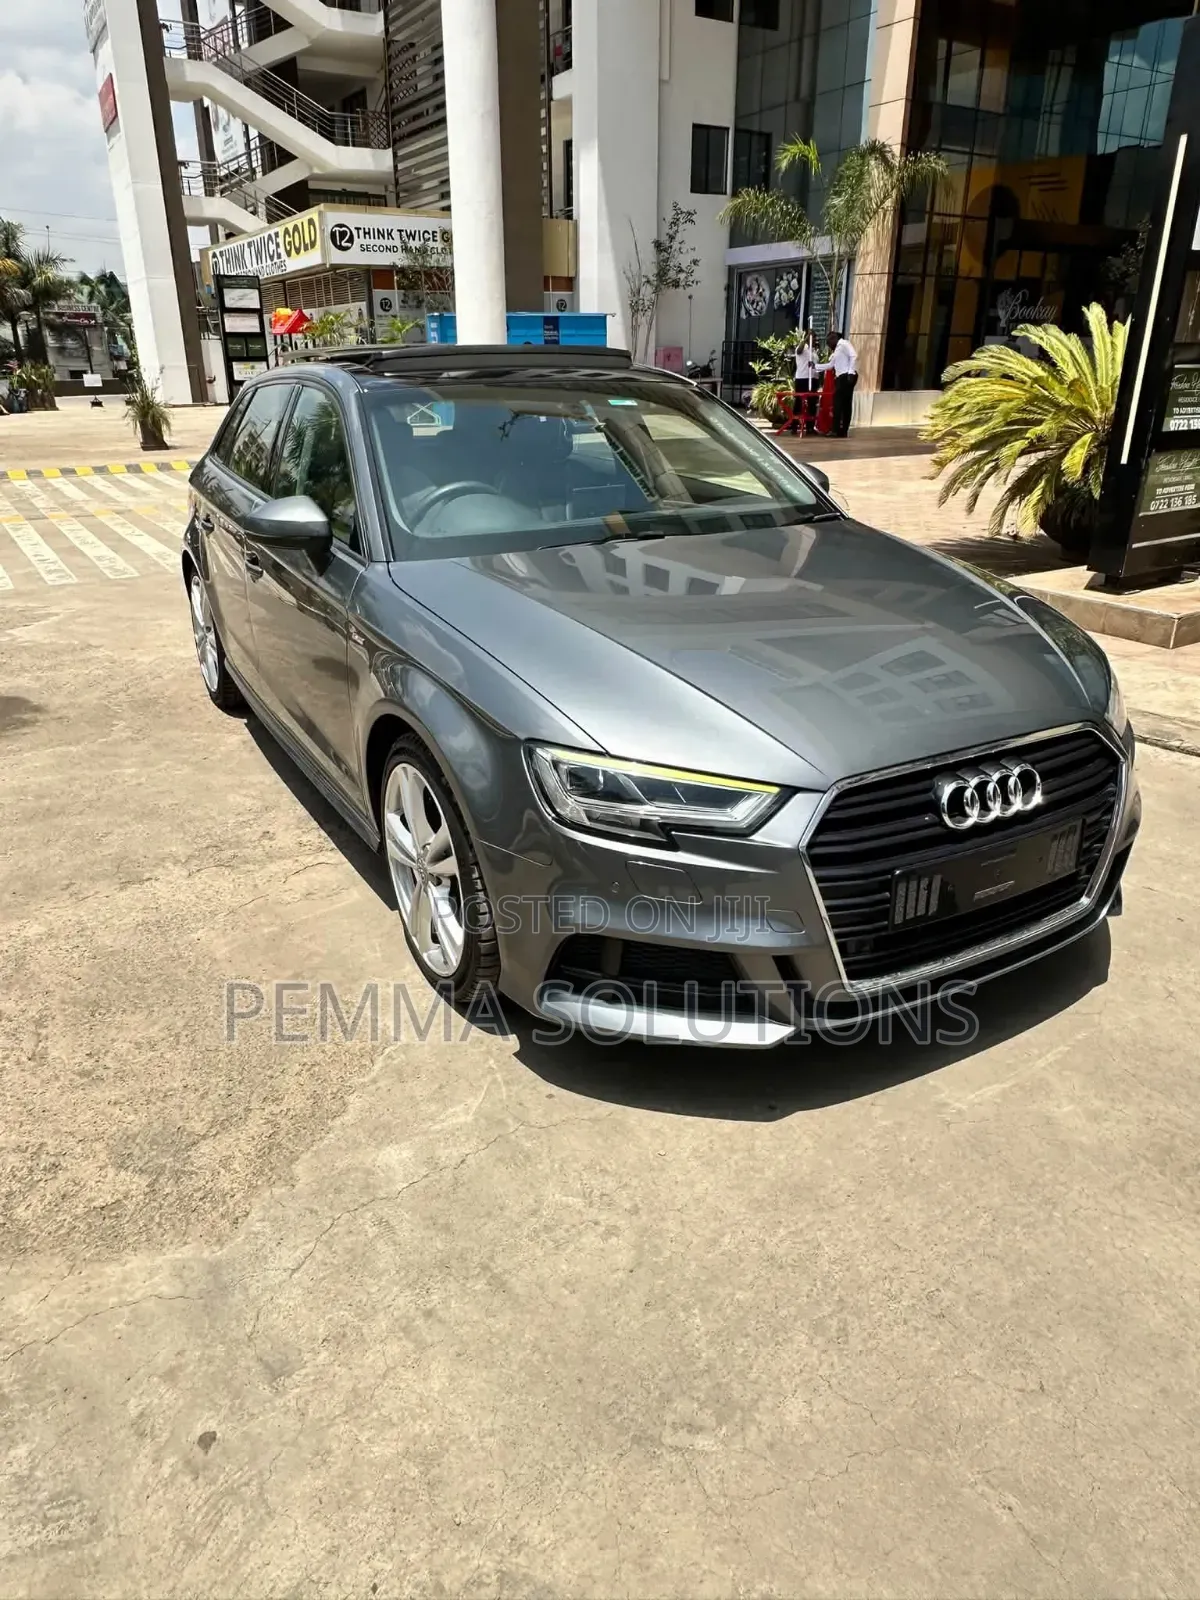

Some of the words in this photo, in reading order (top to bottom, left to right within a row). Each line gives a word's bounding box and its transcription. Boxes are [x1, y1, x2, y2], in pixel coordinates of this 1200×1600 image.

[354, 226, 395, 241] THINK
[396, 228, 438, 242] TWICE
[219, 244, 248, 275] THINK
[247, 231, 282, 267] TWICE
[283, 217, 317, 258] GOLD
[360, 243, 399, 253] SECOND
[1169, 418, 1188, 431] 0722
[1149, 498, 1169, 511] 0722
[1170, 496, 1183, 507] 136
